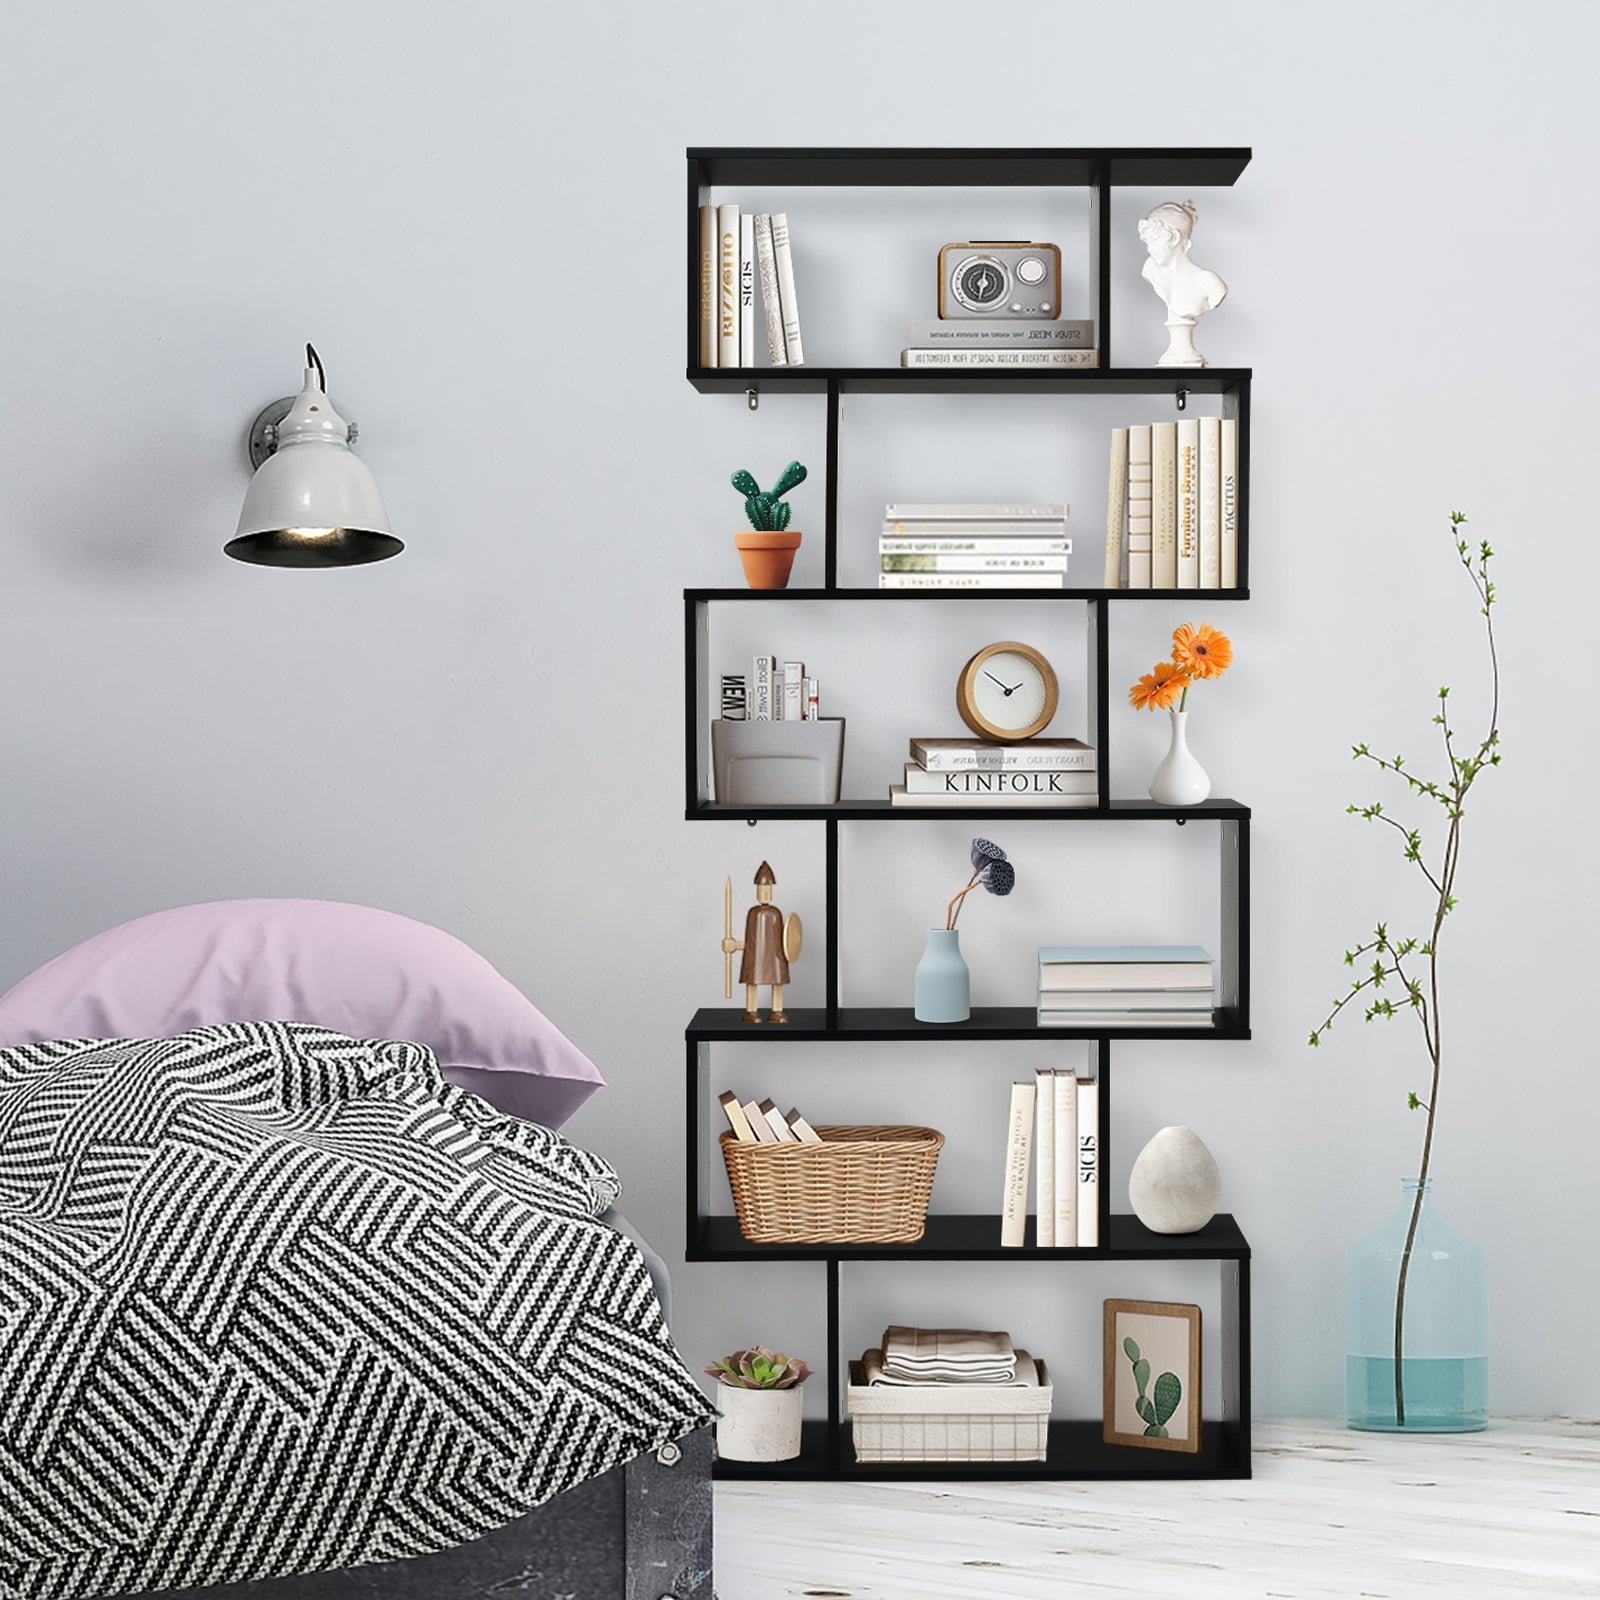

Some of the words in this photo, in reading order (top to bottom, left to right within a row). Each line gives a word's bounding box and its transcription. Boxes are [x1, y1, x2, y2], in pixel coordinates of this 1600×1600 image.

[700, 249, 714, 320] arketipo
[742, 261, 753, 306] SICIS
[1181, 446, 1191, 494] Brands
[1181, 497, 1191, 559] Furniture
[1224, 475, 1235, 533] TACITUS
[945, 773, 1064, 792] KINFOLK
[1007, 1174, 1017, 1221] AROUND
[1013, 1108, 1022, 1144] HOUSE
[1080, 1135, 1096, 1183] SICIS
